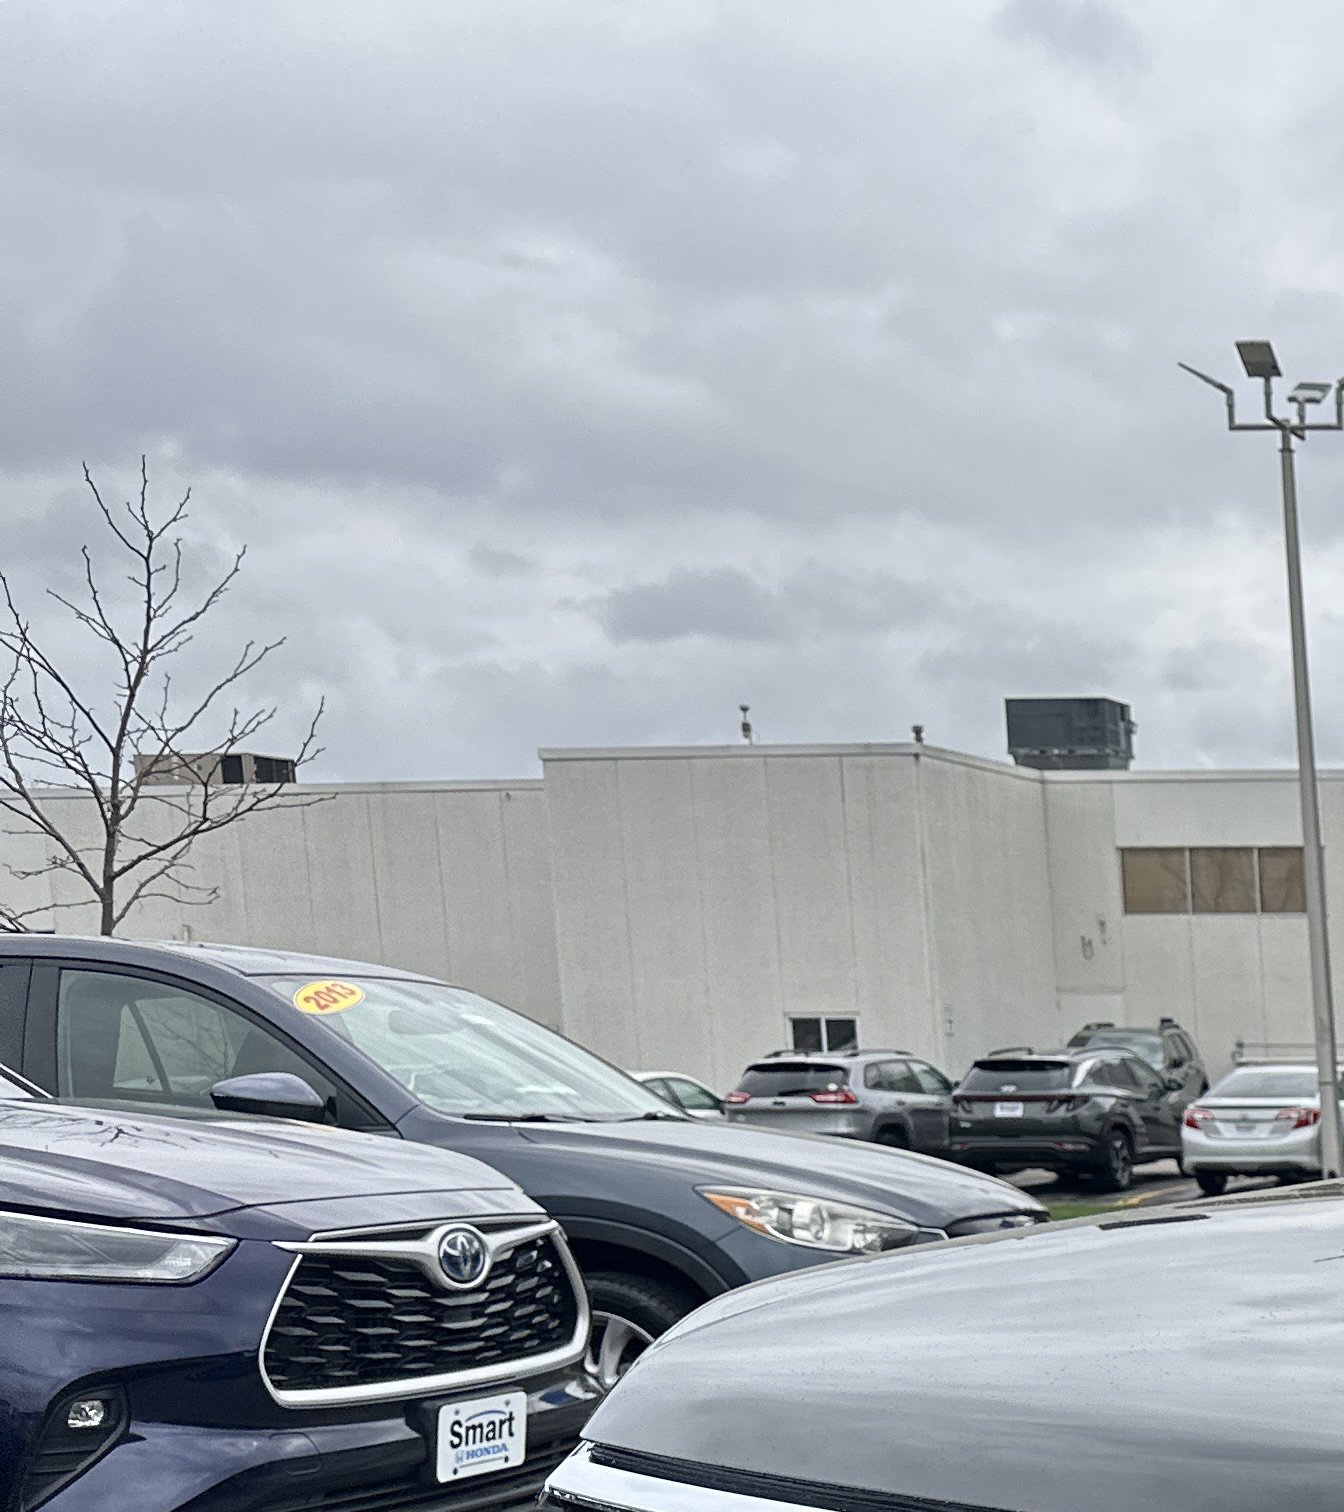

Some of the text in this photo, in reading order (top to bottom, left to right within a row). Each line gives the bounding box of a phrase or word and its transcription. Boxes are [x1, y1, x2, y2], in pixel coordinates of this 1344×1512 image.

[303, 983, 356, 1011] 2013
[449, 1411, 515, 1449] Smart
[465, 1443, 509, 1460] HONDA
